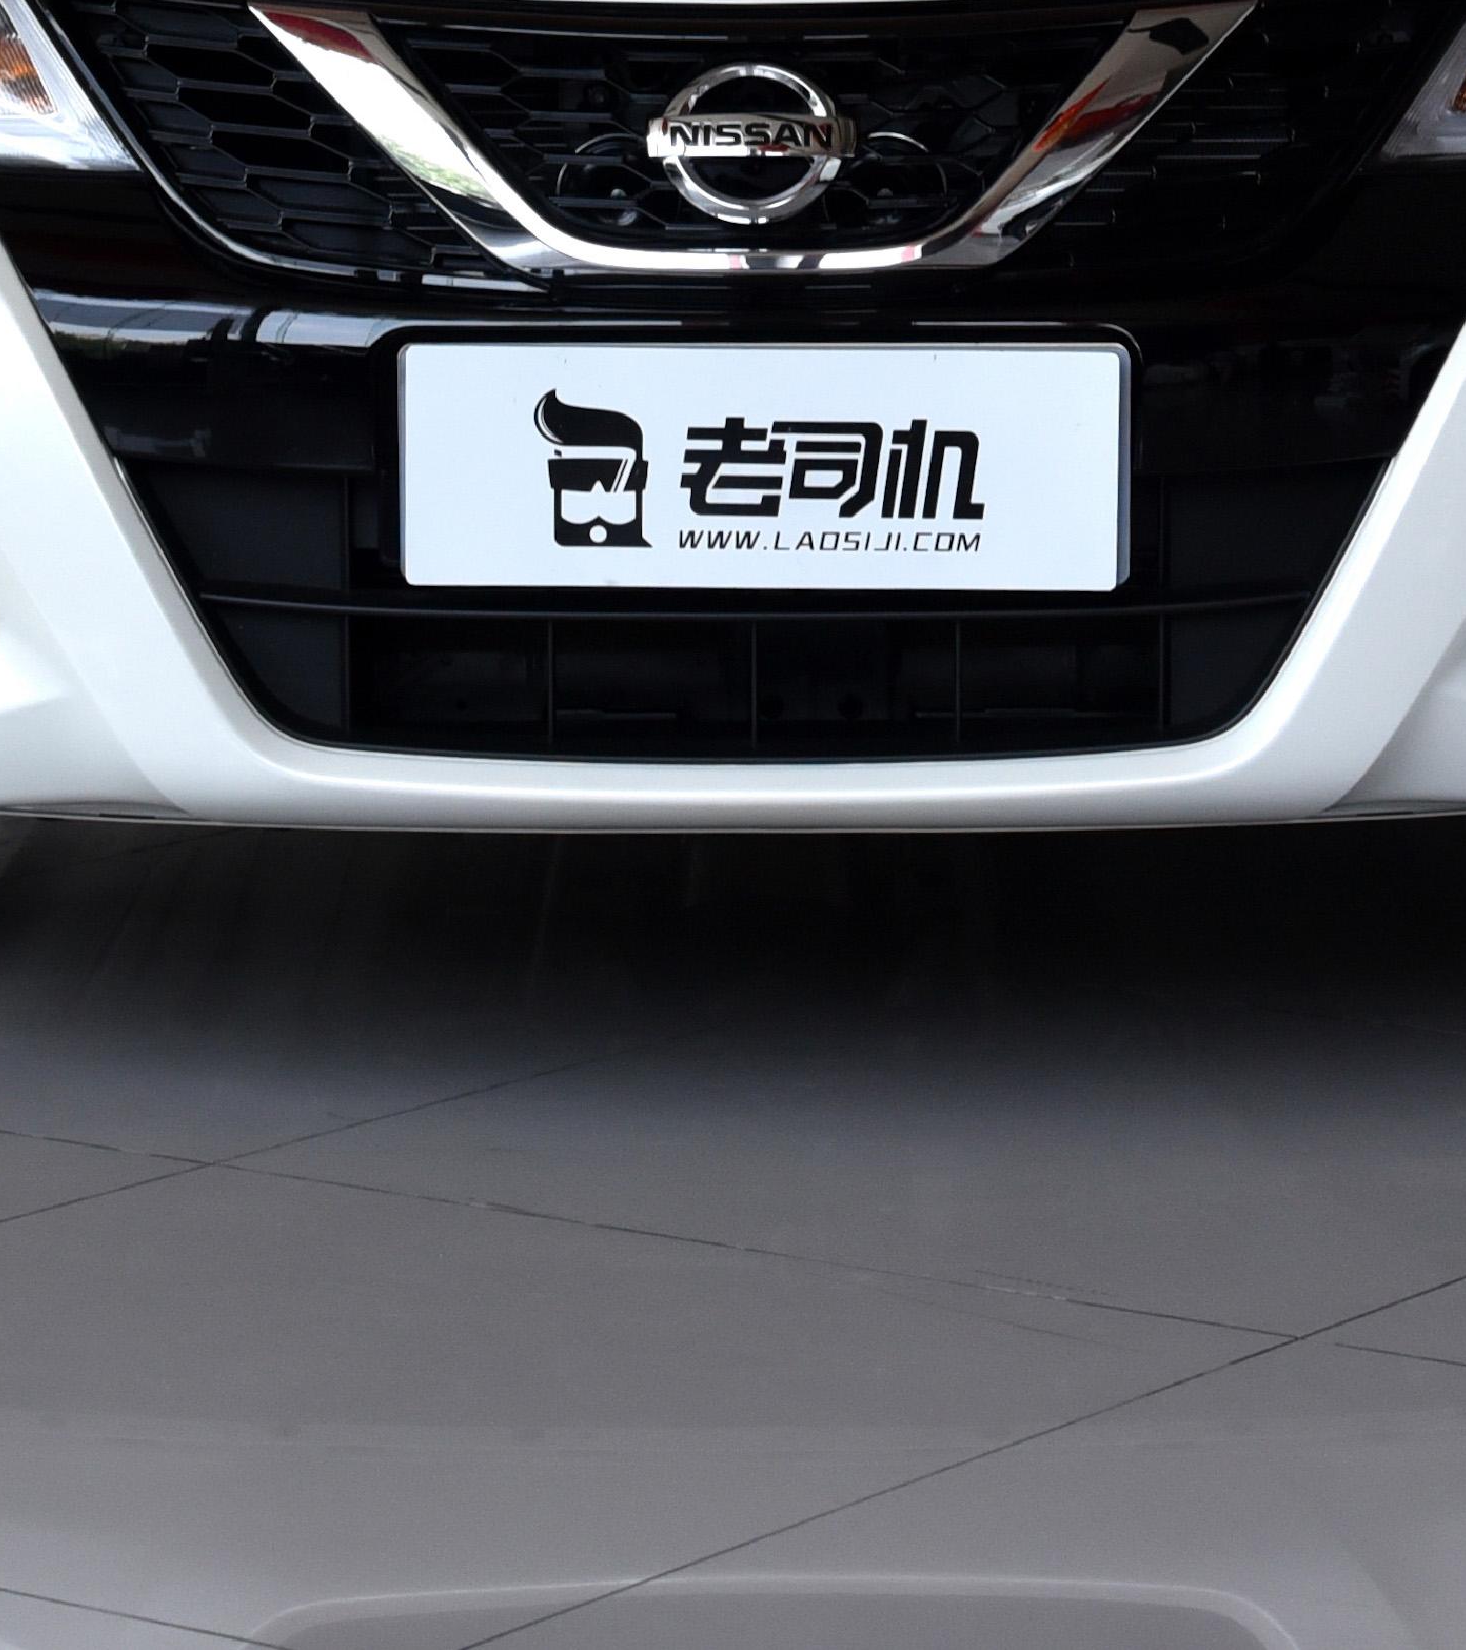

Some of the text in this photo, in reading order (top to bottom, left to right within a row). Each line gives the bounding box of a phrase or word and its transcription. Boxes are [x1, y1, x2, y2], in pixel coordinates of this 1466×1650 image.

[669, 123, 834, 148] NISSAN
[680, 417, 985, 520] 老司机
[679, 529, 981, 553] WWW.LAOSIJI.COM
